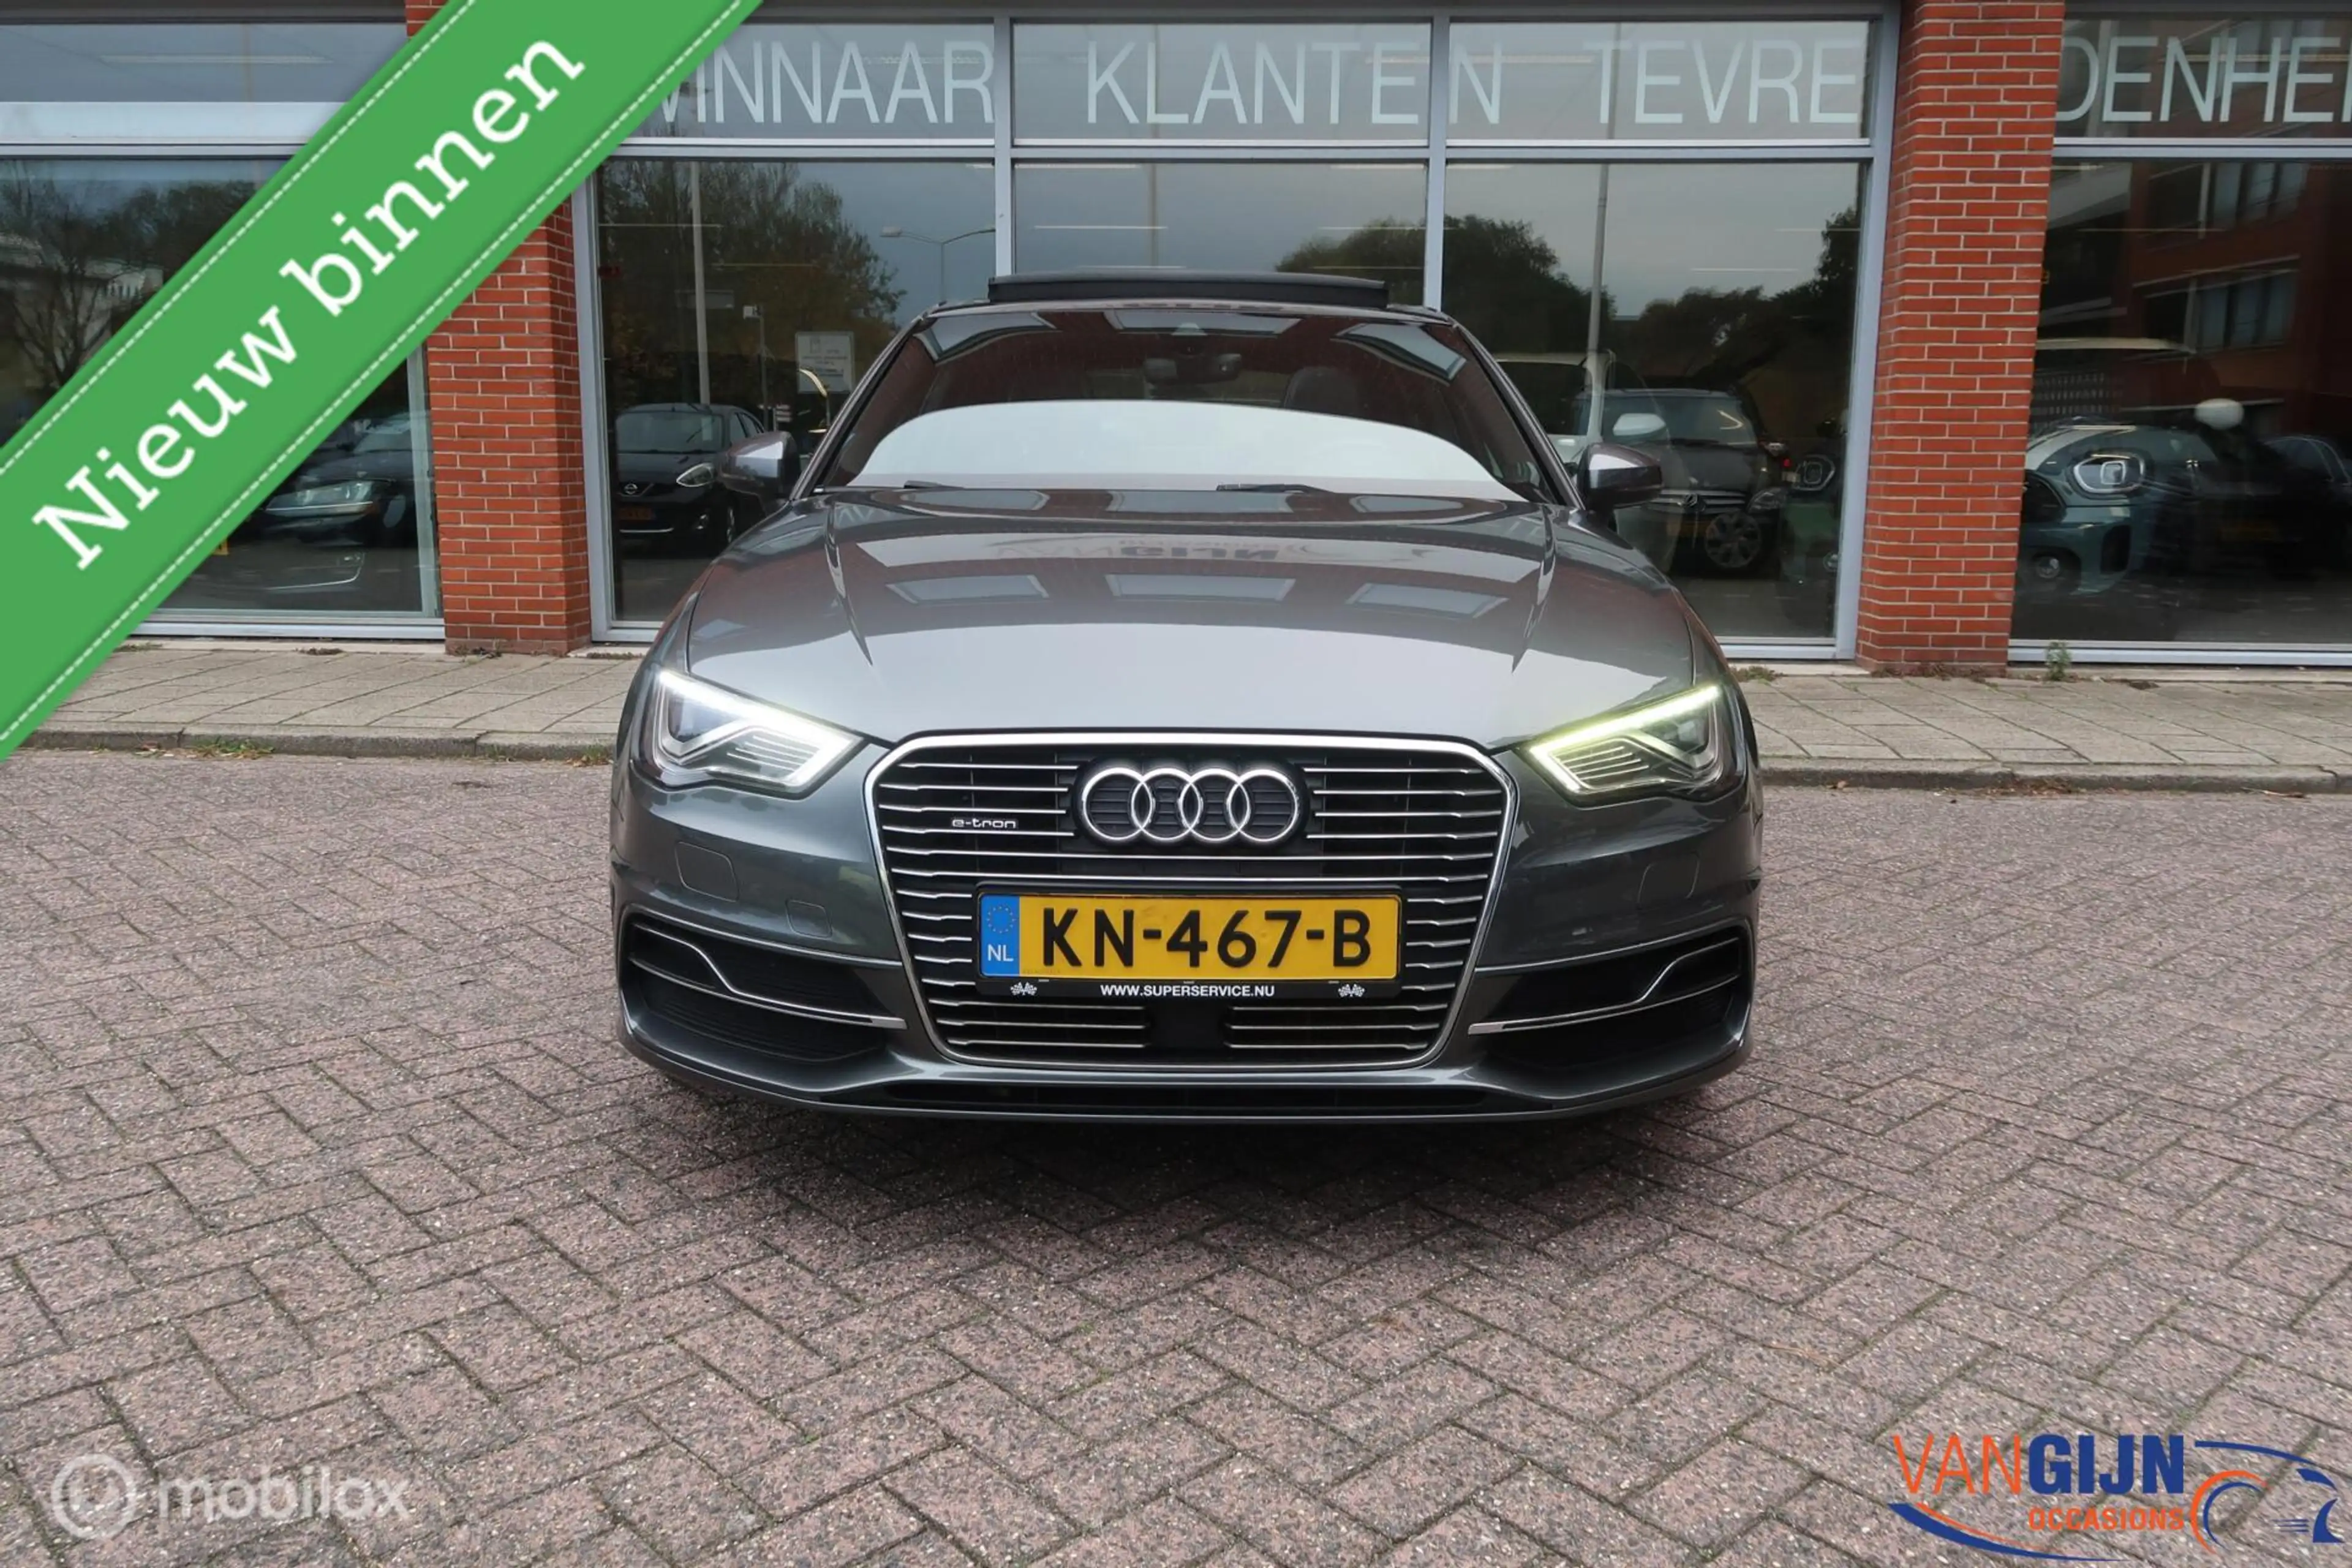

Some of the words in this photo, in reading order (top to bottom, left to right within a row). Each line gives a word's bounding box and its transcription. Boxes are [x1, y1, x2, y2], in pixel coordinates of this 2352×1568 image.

[1087, 41, 1502, 124] KLANTEN
[952, 818, 1017, 829] e-tron
[1043, 907, 1371, 968] KN-467-B
[987, 943, 1014, 962] NL
[1100, 984, 1275, 997] WWW.SUPERSERVICE.NU
